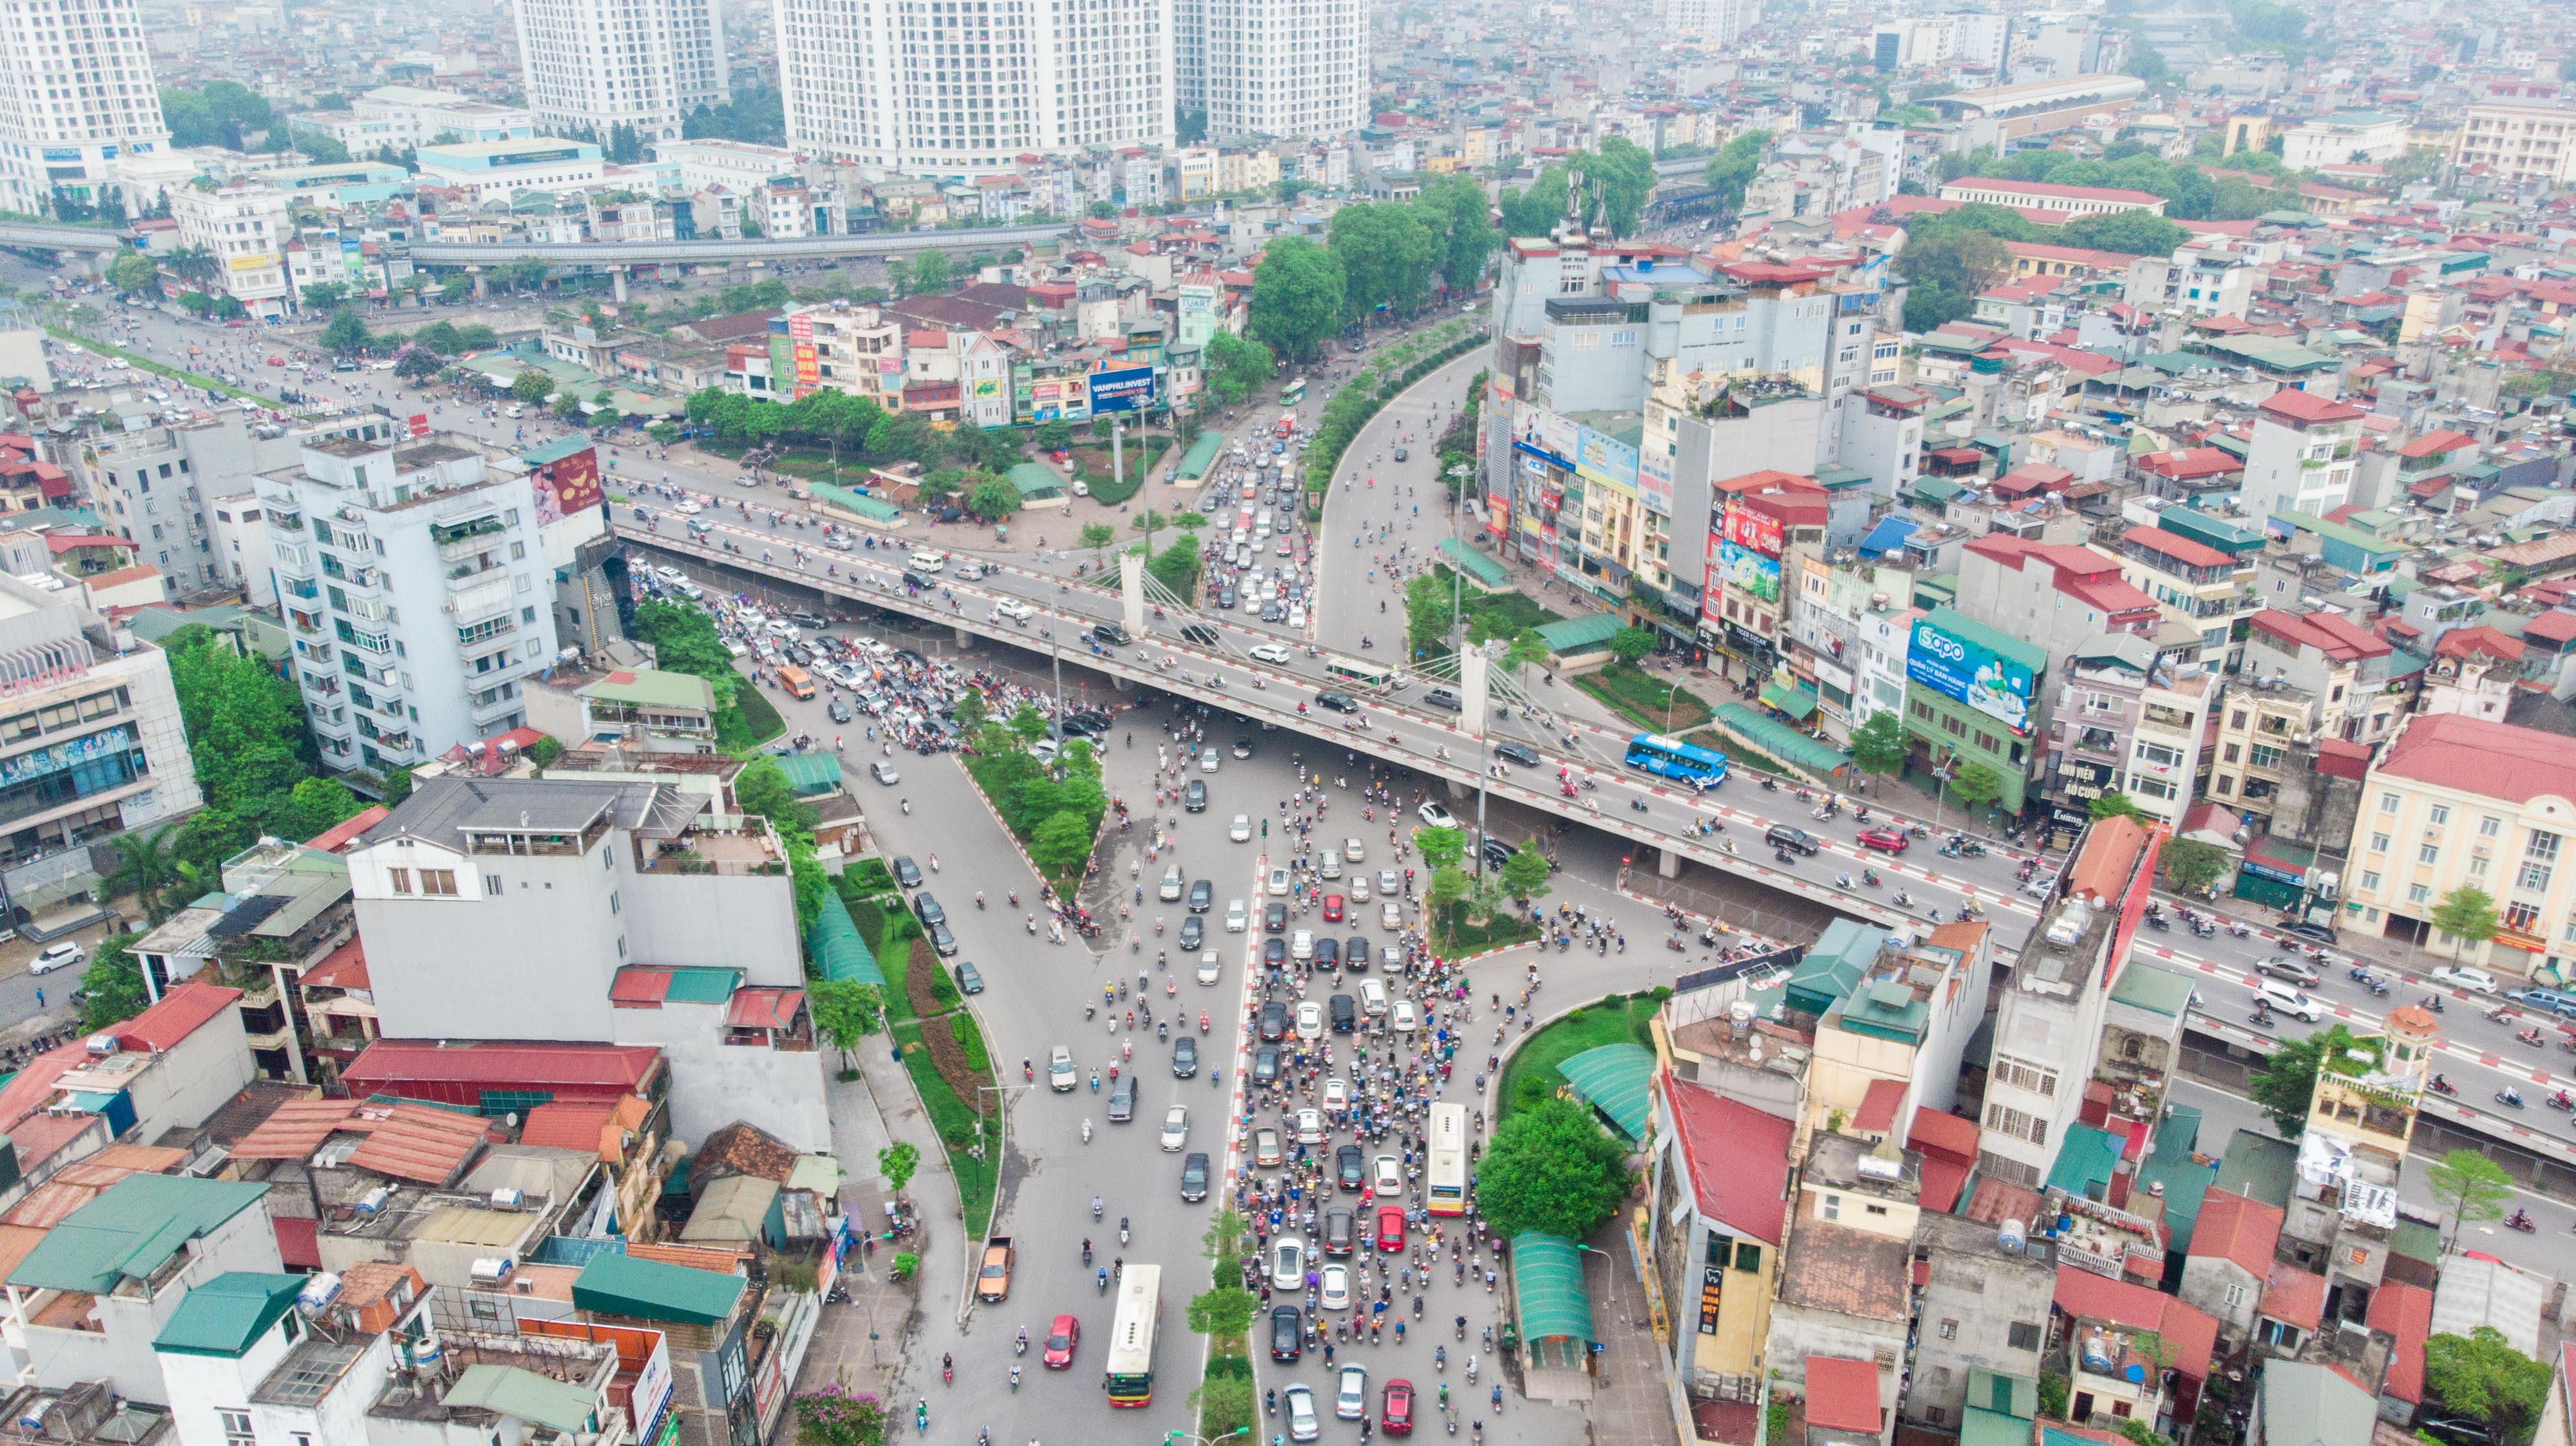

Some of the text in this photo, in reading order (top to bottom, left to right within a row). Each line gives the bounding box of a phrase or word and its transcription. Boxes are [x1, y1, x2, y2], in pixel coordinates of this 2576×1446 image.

[1182, 298, 1211, 307] TUART
[1093, 378, 1151, 392] VANPHU.INVEST
[592, 592, 612, 608] Spa
[1736, 627, 1767, 647] TIGER SUGAR
[0, 662, 89, 698] CINEMA
[1935, 670, 1948, 680] BÁN
[1948, 676, 1966, 689] HÀNG
[2076, 766, 2096, 783] VIỆN
[2064, 780, 2078, 796] ÁO
[1705, 1286, 1719, 1295] NHA
[1702, 1304, 1718, 1314] VIỆT
